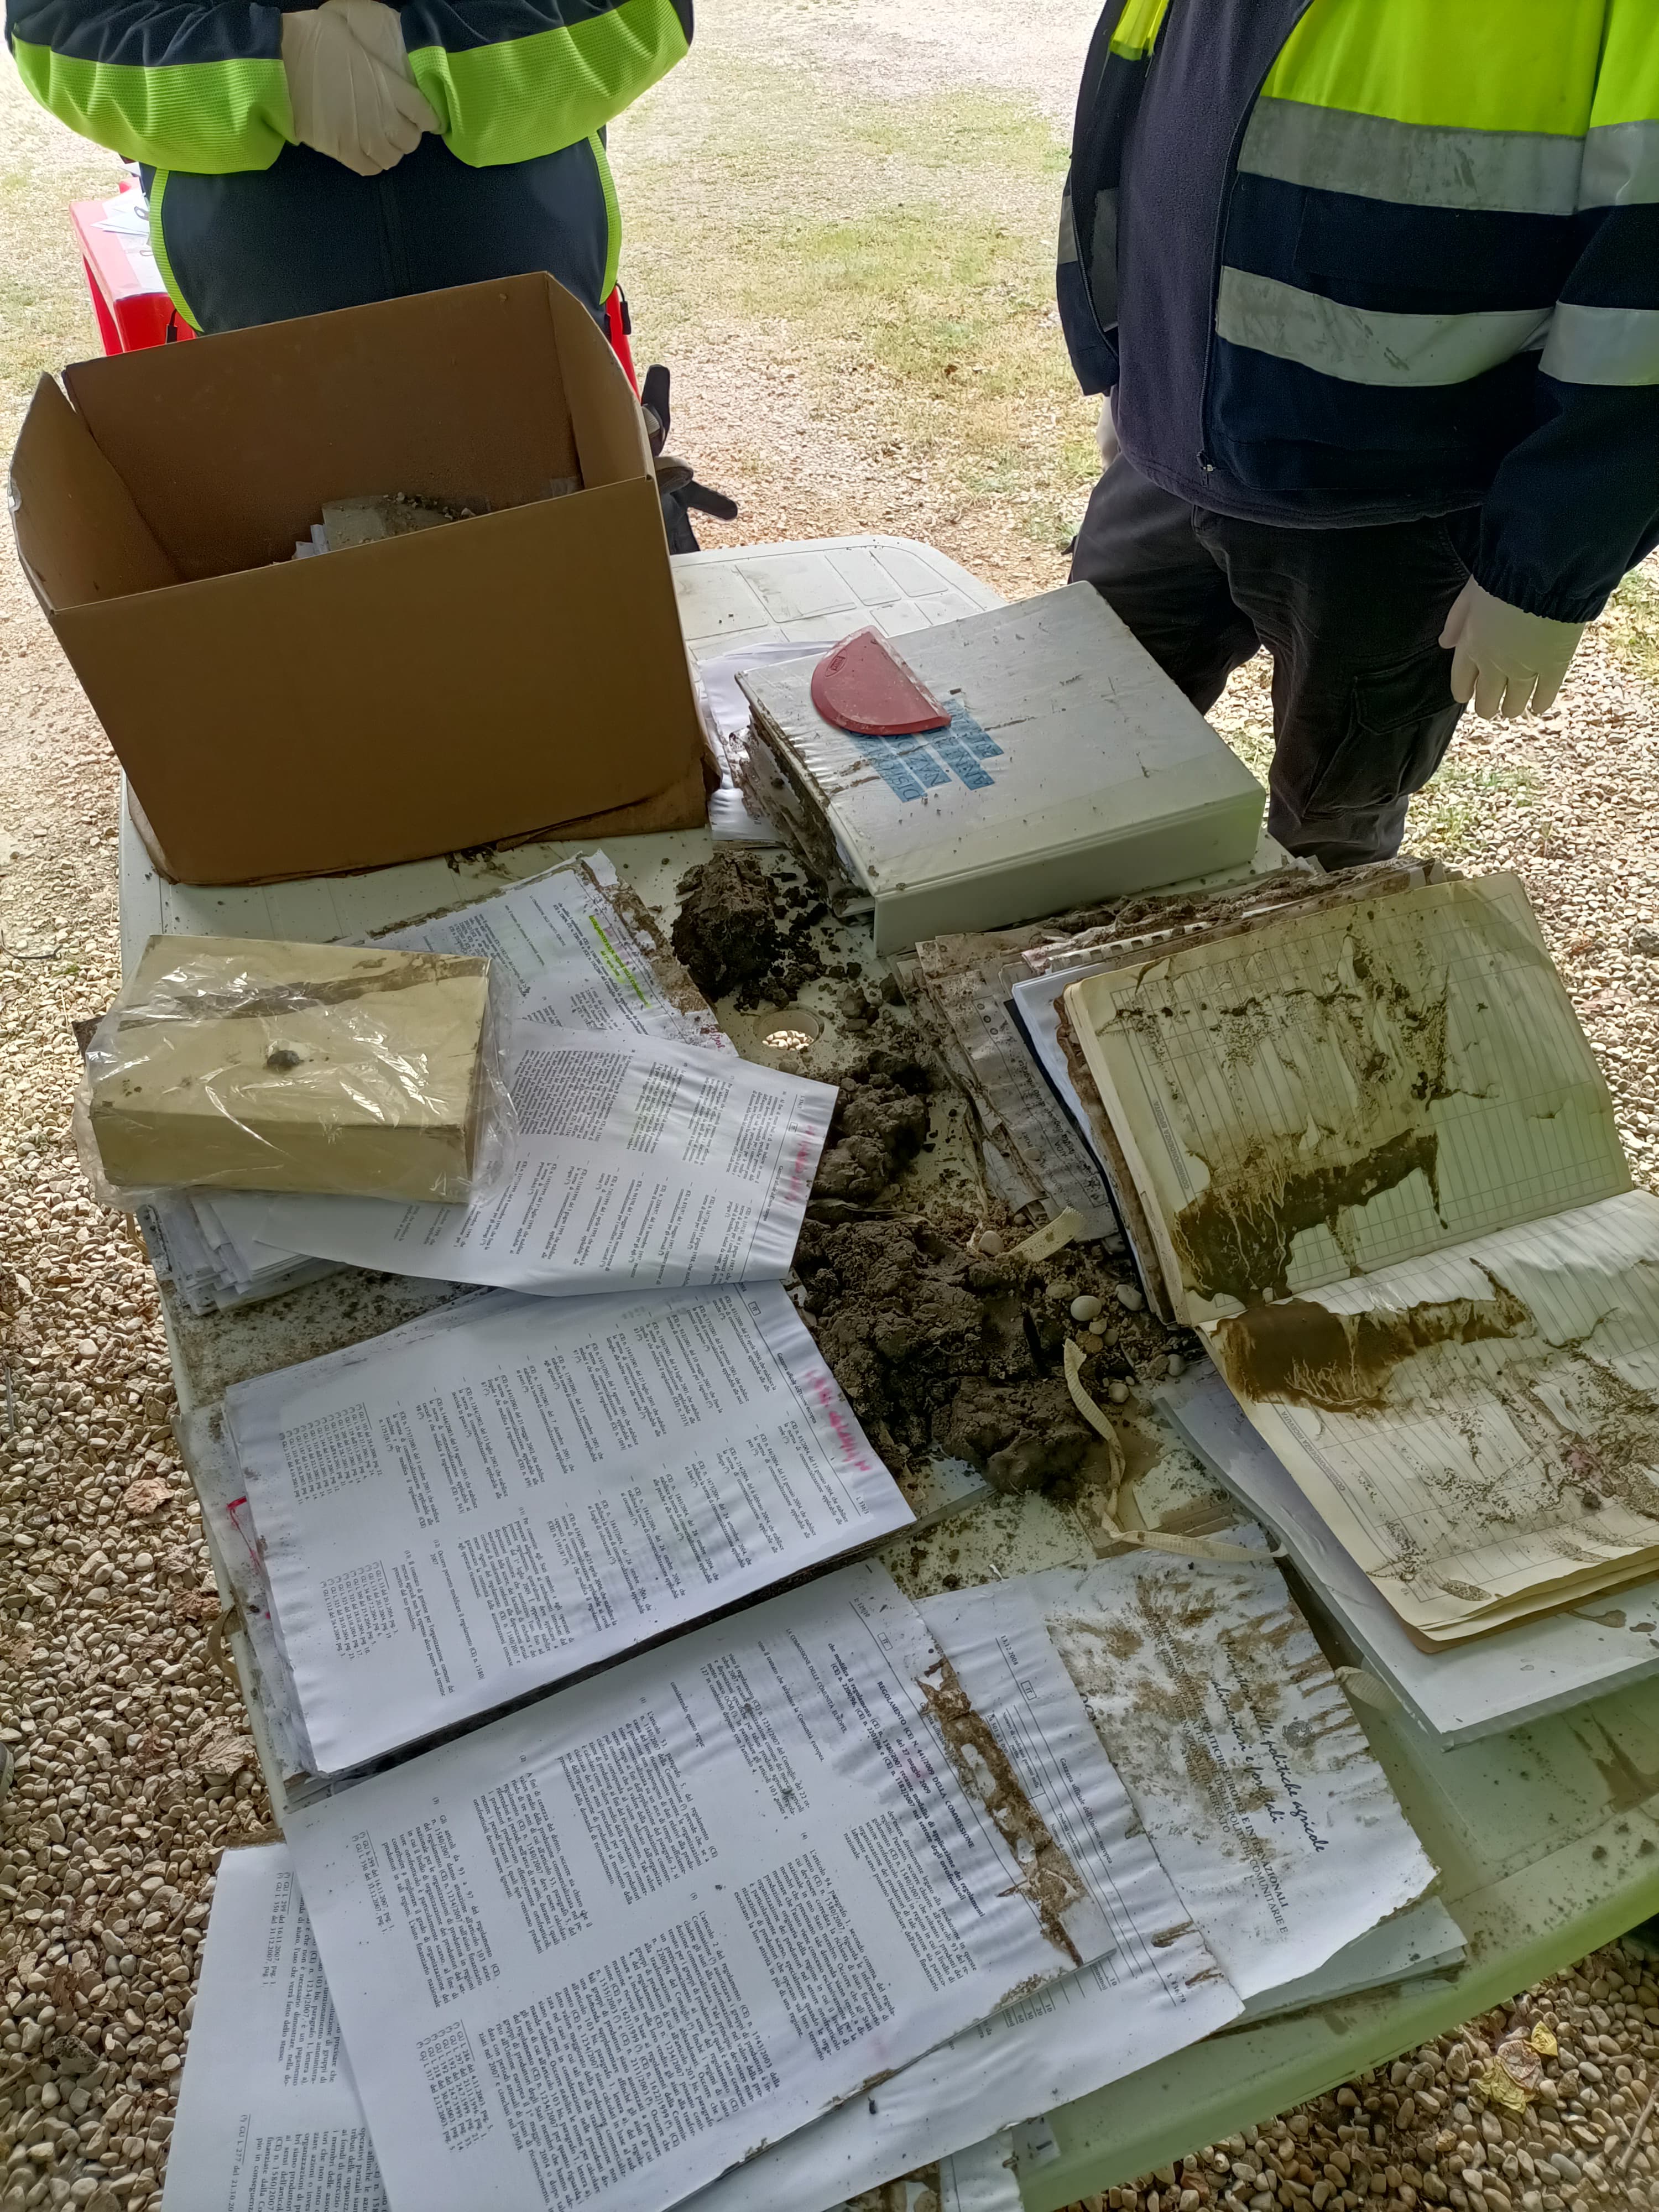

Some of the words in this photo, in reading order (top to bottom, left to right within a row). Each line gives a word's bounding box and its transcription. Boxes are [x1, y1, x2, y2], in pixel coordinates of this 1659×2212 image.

[1153, 1101, 1168, 1129] SPEDITA
[1164, 1129, 1190, 1190] CORRISPONDENZA
[1281, 1411, 1305, 1439] RICEVUTA
[1303, 1439, 1346, 1491] CORRISPONDENZA
[857, 1602, 870, 1618] 129/10
[785, 1627, 792, 1636] LA
[808, 1665, 820, 1682] DELLE
[817, 1681, 835, 1709] COMUNITÀ
[1221, 1639, 1259, 1704] Ministero
[766, 1656, 779, 1674] trattato
[776, 1675, 784, 1685] che
[781, 1684, 796, 1707] istituisce
[797, 1713, 814, 1740] Comunità
[1211, 1679, 1253, 1751] alimentari
[1249, 1703, 1274, 1738] delle
[896, 1738, 905, 1748] del
[902, 1747, 911, 1756] 27
[1171, 1695, 1206, 1772] INTERNAZIONALI
[830, 1663, 841, 1676] (CE)
[854, 1708, 866, 1720] (CE)
[867, 1727, 883, 1750] 2201/96
[882, 1756, 894, 1770] (CE)
[895, 1777, 915, 1807] 1182/2007
[912, 1809, 922, 1820] nel
[919, 1821, 935, 1843] settore
[931, 1844, 943, 1859] degli
[940, 1860, 966, 1901] ortofrutticoli
[877, 1681, 907, 1725] REGOLAMENTO
[903, 1726, 915, 1740] (CE)
[917, 1749, 935, 1776] 441/2009
[932, 1776, 947, 1799] DELLA
[945, 1800, 974, 1849] COMMISSIONE
[906, 1757, 921, 1778] maggio
[1190, 1772, 1200, 1783] IV
[1201, 1773, 1212, 1786] DI
[1242, 1754, 1259, 1765] e
[1261, 1740, 1301, 1797] politiche
[834, 1653, 849, 1677] modifica
[851, 1683, 872, 1718] regolamento
[869, 1718, 881, 1730] (CE)
[883, 1739, 902, 1768] 1580/2007
[900, 1770, 914, 1792] recante
[912, 1793, 930, 1819] modalità
[932, 1829, 955, 1868] applicazione
[954, 1870, 963, 1881] dei
[960, 1882, 985, 1918] regolamenti
[919, 1779, 931, 1794] 2009
[1186, 1686, 1203, 1717] DELLE
[1201, 1717, 1227, 1769] POLITICHE
[1222, 1770, 1247, 1815] EUROPEE
[1242, 1816, 1250, 1824] E
[1246, 1825, 1288, 1907] INTERNAZIONALI
[1246, 1764, 1284, 1823] forestali
[1177, 1692, 1190, 1710] PER
[1192, 1719, 1218, 1778] ATTUAZIONE
[1214, 1778, 1233, 1810] DELLE
[1228, 1810, 1254, 1859] POLITICHE
[1250, 1858, 1285, 1925] COMUNITARIE
[1280, 1926, 1288, 1934] E
[1206, 1786, 1230, 1833] MERCATO
[1292, 1801, 1327, 1853] agricole
[362, 1840, 371, 1850] GU
[367, 1856, 375, 1867] 299
[283, 1881, 289, 1891] GU
[1090, 1964, 1108, 1991] (minimo)
[457, 2031, 465, 2042] GU
[462, 2049, 471, 2062] 286
[467, 2063, 475, 2074] del
